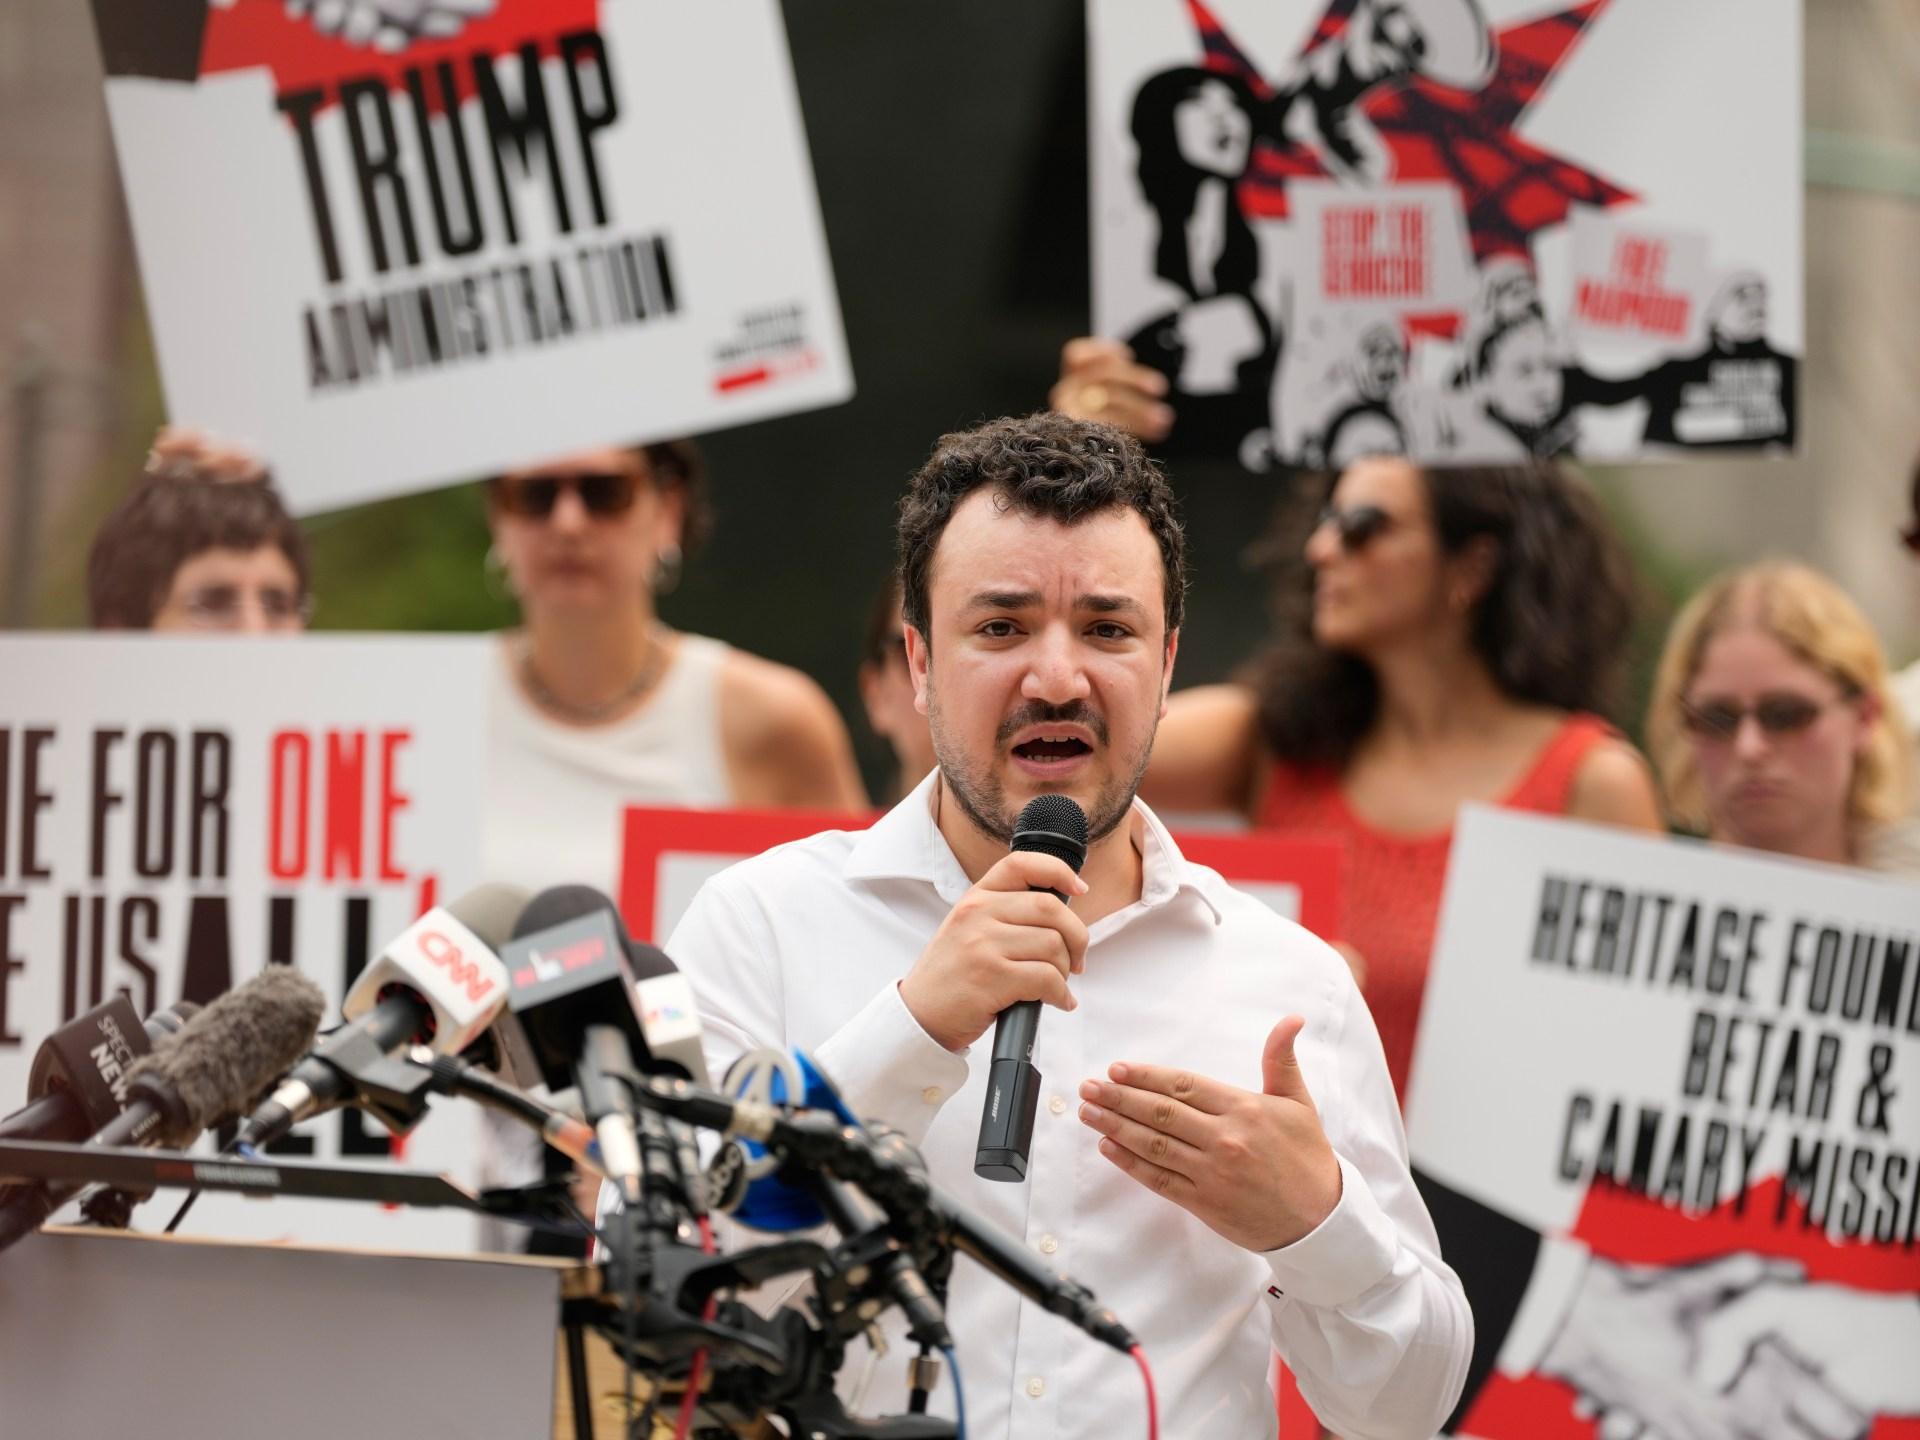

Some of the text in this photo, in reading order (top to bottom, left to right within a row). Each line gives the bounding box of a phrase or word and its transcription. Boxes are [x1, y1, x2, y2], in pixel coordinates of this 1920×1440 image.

[277, 30, 620, 284] TRUMP
[304, 233, 681, 389] ADMINISTRATION
[91, 729, 231, 879] FOR
[417, 928, 495, 1004] CNN
[1529, 874, 1769, 1001] HERITAGE
[1682, 1010, 1896, 1134] BETAR &
[1557, 1092, 1767, 1217] CANARY
